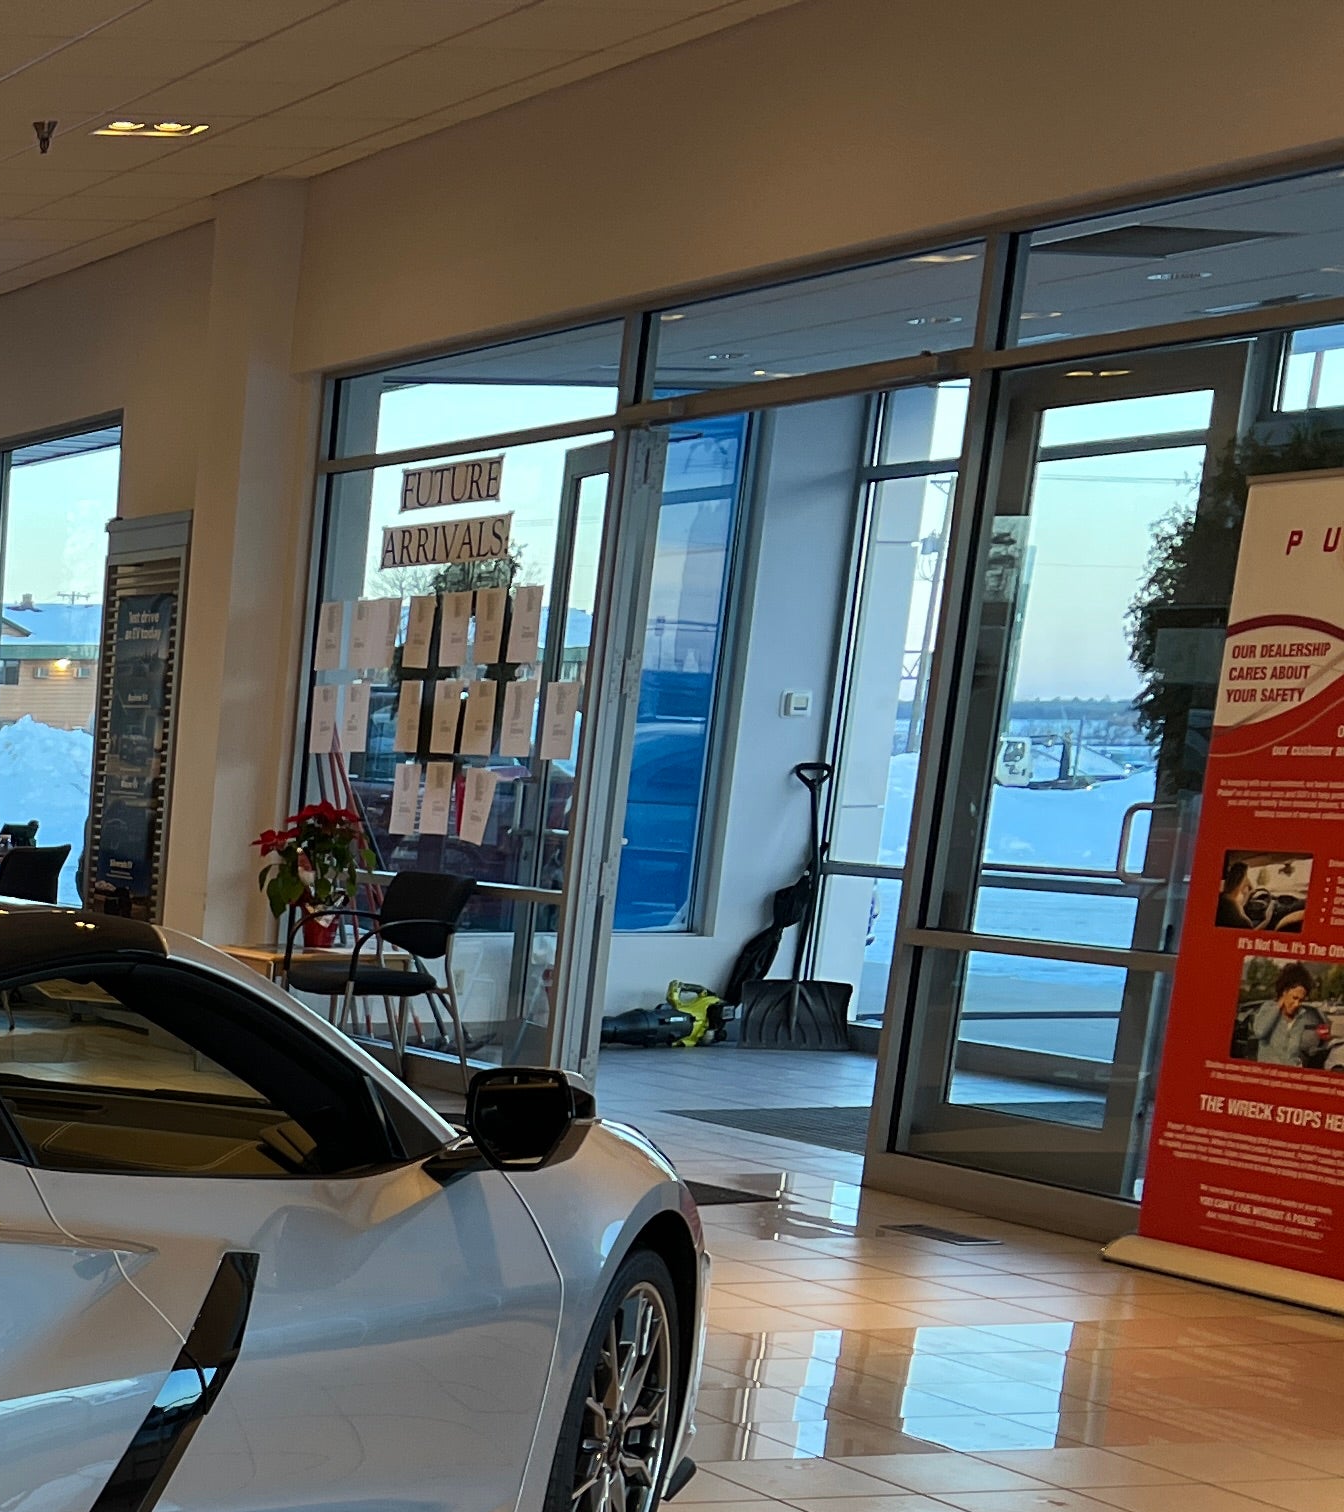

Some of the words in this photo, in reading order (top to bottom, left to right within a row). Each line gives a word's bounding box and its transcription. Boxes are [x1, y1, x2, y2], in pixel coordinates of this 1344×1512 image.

[403, 463, 502, 508] FUTURE
[1232, 645, 1256, 659] OUR
[1260, 642, 1332, 658] DEALERSHIP
[1229, 667, 1267, 681] CARES
[1270, 665, 1311, 680] ABOUT
[1226, 689, 1257, 703] YOUR
[1260, 687, 1305, 702] SAFETY
[1200, 1094, 1225, 1113] THE
[1228, 1099, 1274, 1121] WRECK
[1276, 1106, 1322, 1129] STOPS
